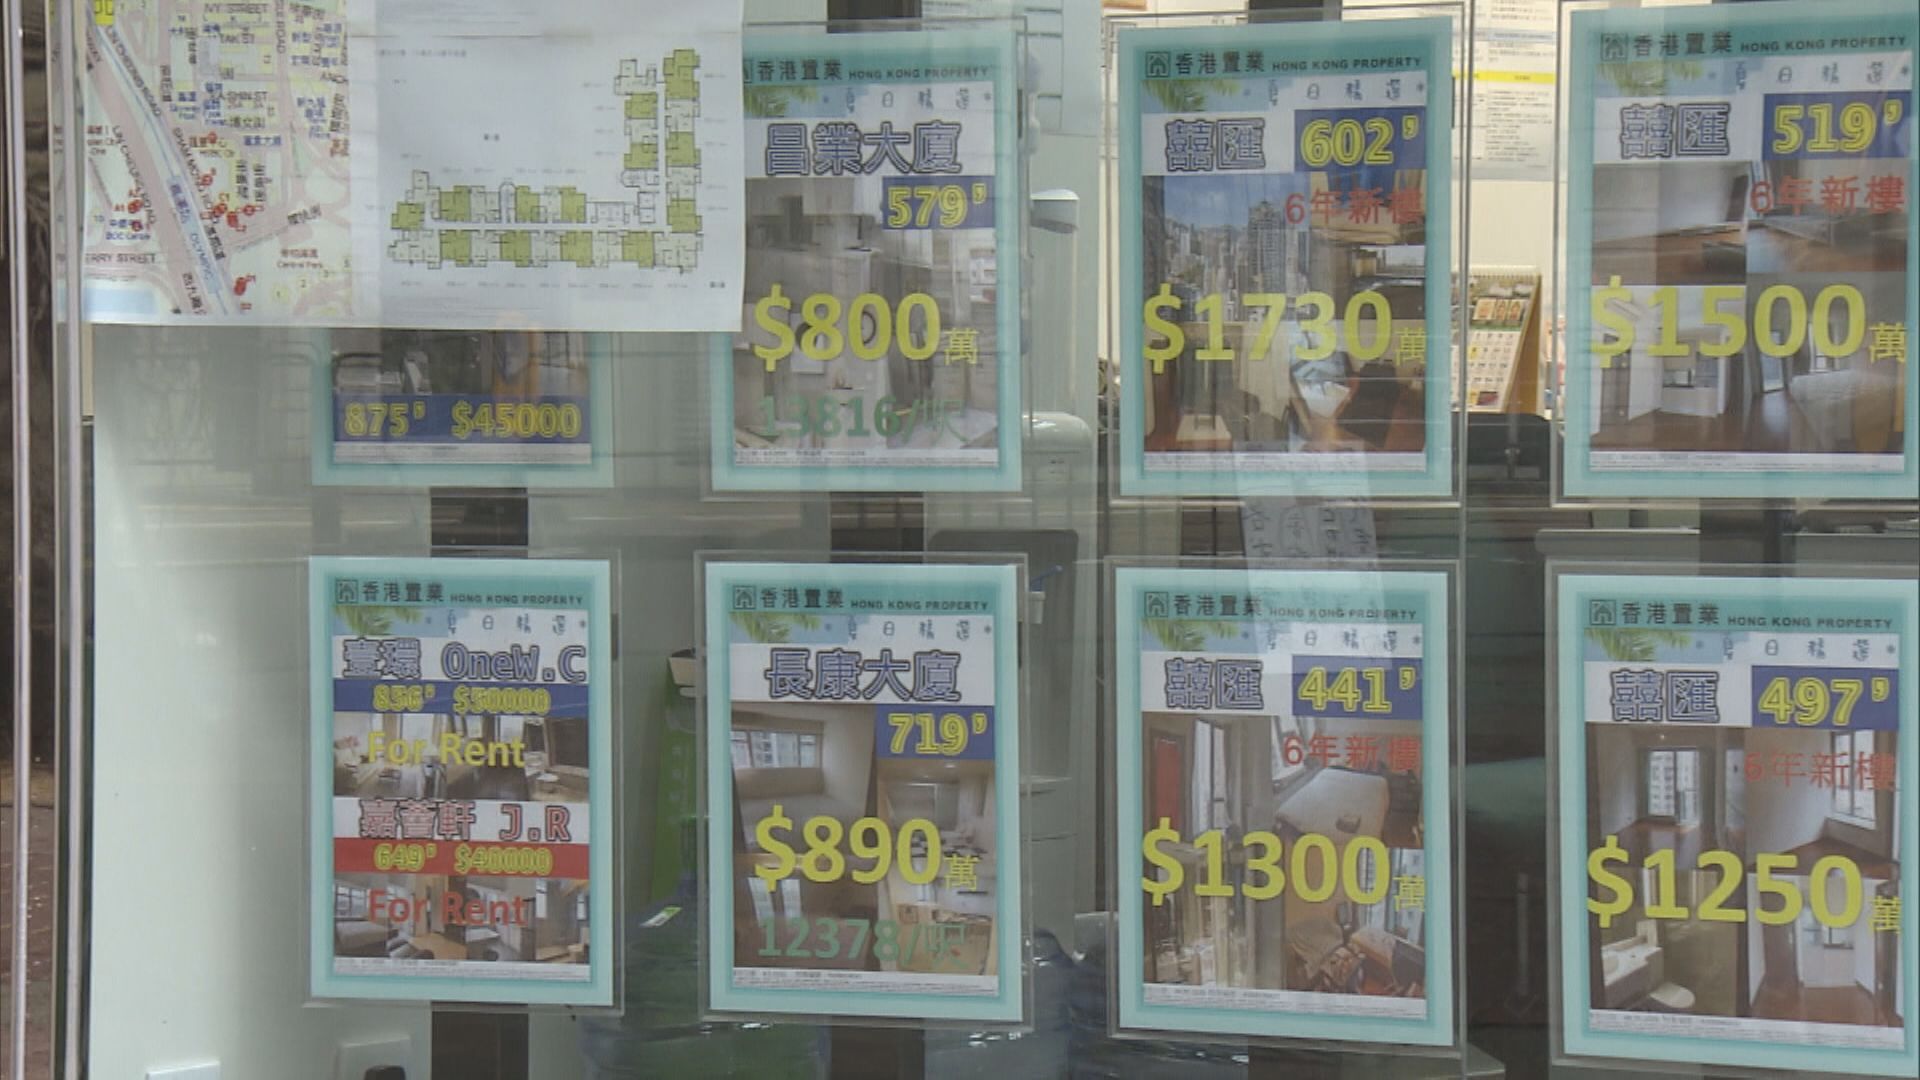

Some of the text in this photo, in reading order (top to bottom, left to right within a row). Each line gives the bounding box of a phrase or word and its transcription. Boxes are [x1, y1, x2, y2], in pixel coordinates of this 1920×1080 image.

[1633, 32, 1732, 56] 香港置業
[1740, 36, 1906, 52] HONG KONG PROPERTY
[757, 59, 842, 80] 香港置業
[849, 66, 988, 79] HONG KONG PROPERTY
[1175, 52, 1265, 74] 香港置業
[1272, 57, 1421, 71] HONG KONG PROPERTY
[765, 121, 963, 175] 昌業大廈
[1751, 175, 1906, 216] 6年新樓
[452, 400, 581, 438] $45000
[362, 581, 445, 602] 香港置業
[451, 595, 583, 605] HONG KONG PROPERTY
[760, 588, 843, 608] 香港置業
[851, 601, 988, 611] HONG KONG PROPERTY
[1173, 595, 1263, 617] 香港置業
[1269, 608, 1417, 620] HONG KONG PROPERTY
[1621, 603, 1720, 626] 香港置業
[1728, 616, 1893, 629] HONG KONG PROPERTY
[441, 641, 587, 682] OneW.C
[765, 648, 961, 702] 長康大廈
[452, 684, 551, 714] $50000
[367, 731, 527, 768] For Rent
[499, 803, 571, 842] J.R
[454, 843, 553, 876] $40000
[368, 888, 529, 927] For Rent
